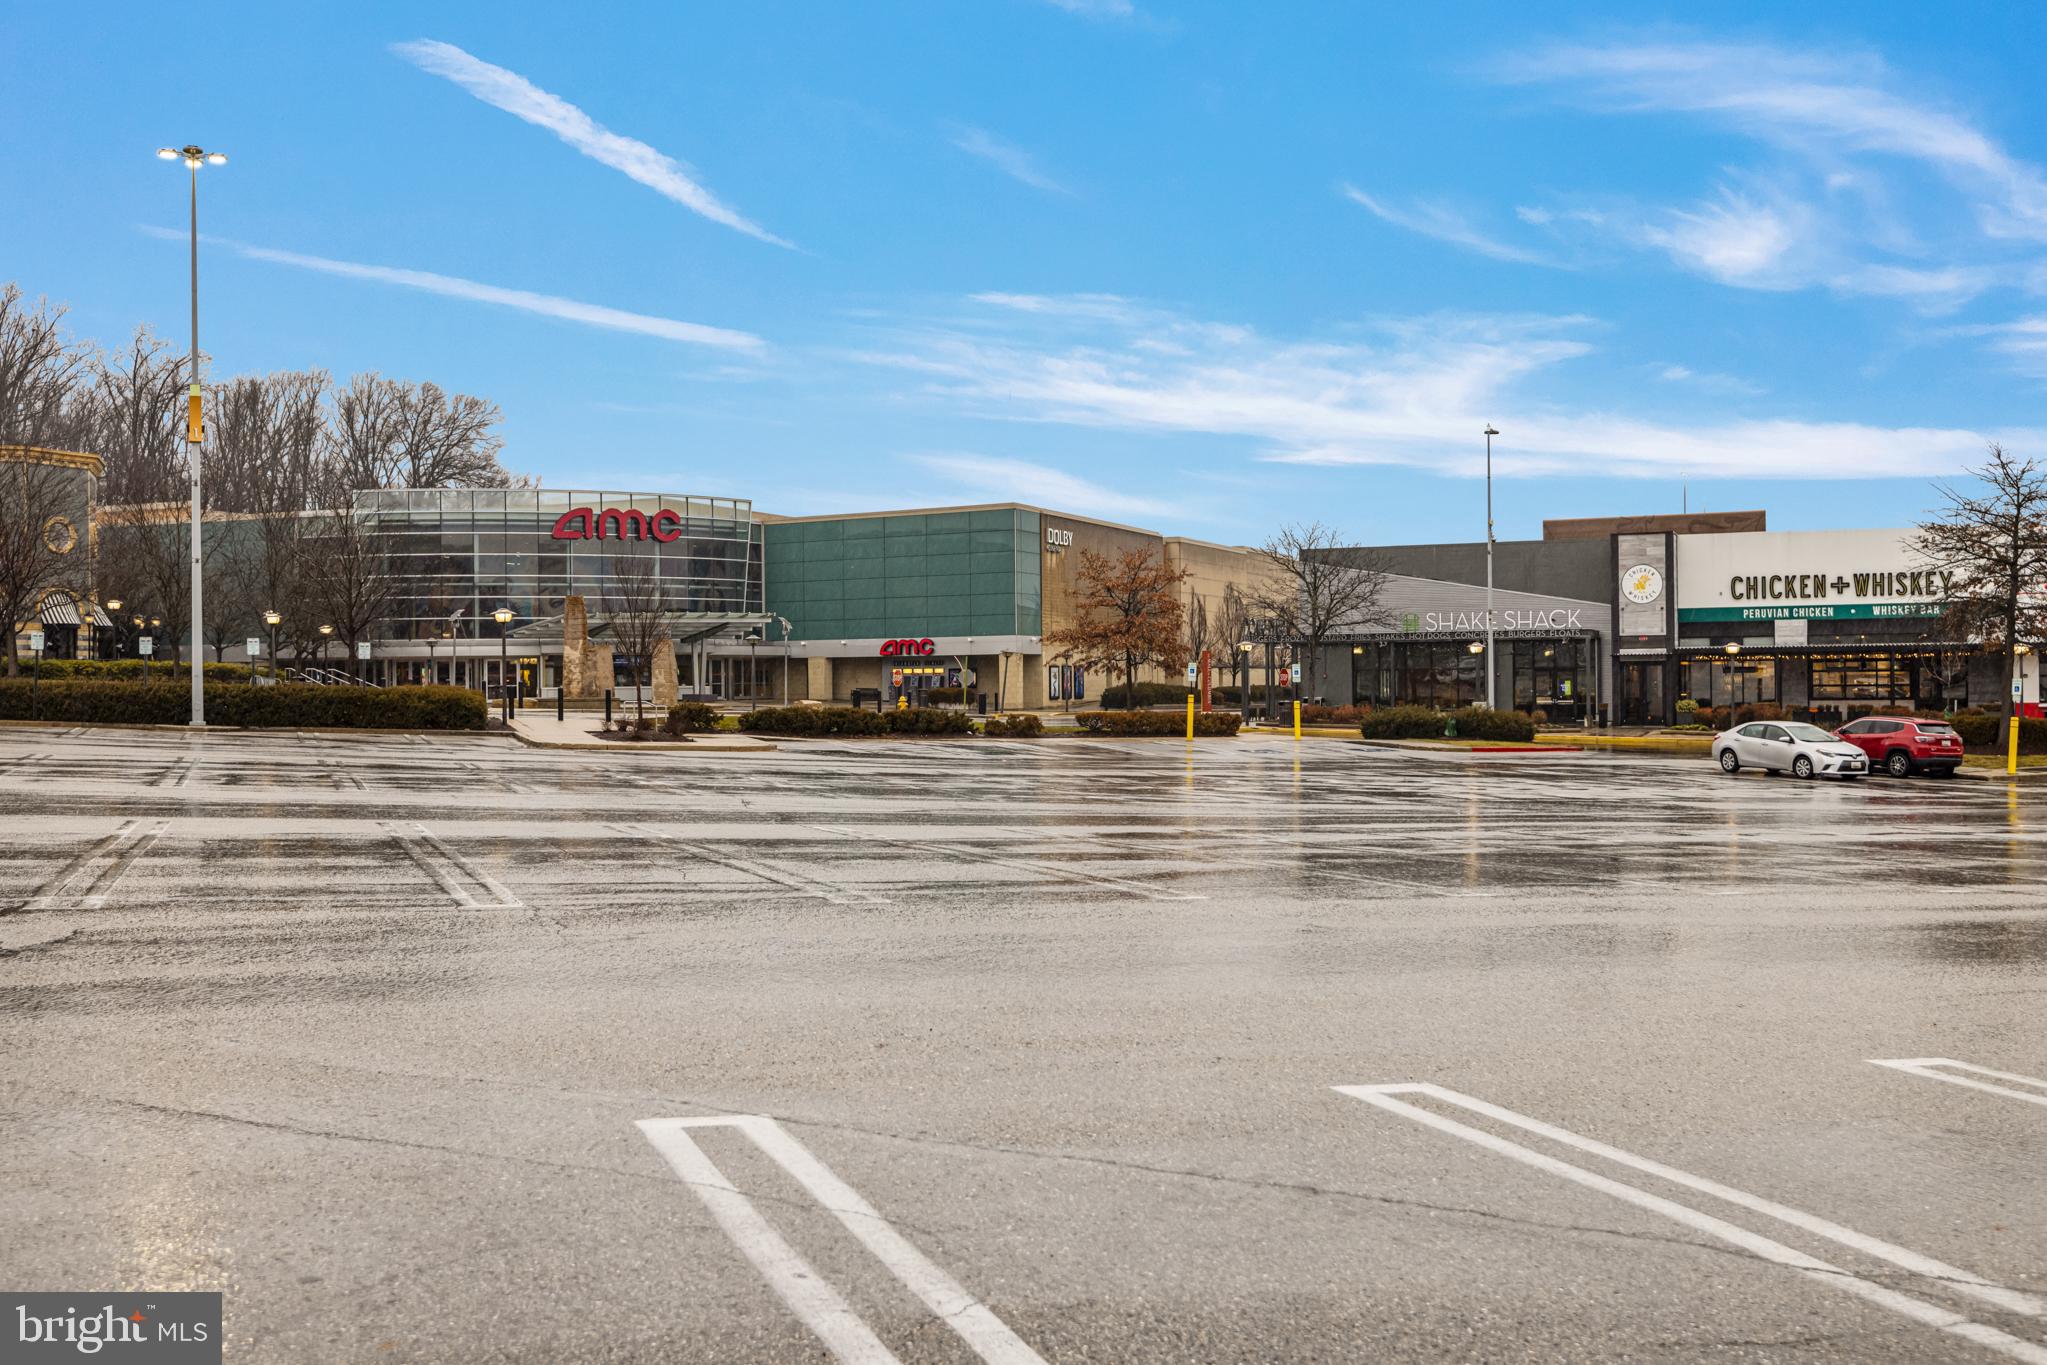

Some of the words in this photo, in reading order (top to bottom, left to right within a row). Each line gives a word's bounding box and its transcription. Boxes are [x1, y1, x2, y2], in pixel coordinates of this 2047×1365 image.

[1048, 528, 1073, 546] DOLBY
[1628, 567, 1655, 578] CHICKEN
[1628, 590, 1657, 601] WHISKEY
[1743, 607, 1789, 619] PERUVIAN
[1792, 606, 1834, 618] CHICKEN
[1872, 604, 1916, 616] WHISKEY
[1425, 611, 1498, 631] SHAKE
[1504, 609, 1582, 630] SHACK
[1375, 632, 1405, 641] SHAKES
[1409, 632, 1426, 640] HOT
[1428, 632, 1450, 640] DOGS
[1455, 631, 1504, 639] CONCREES
[1508, 630, 1546, 639] BURGERS
[1550, 629, 1581, 638] FLOATS
